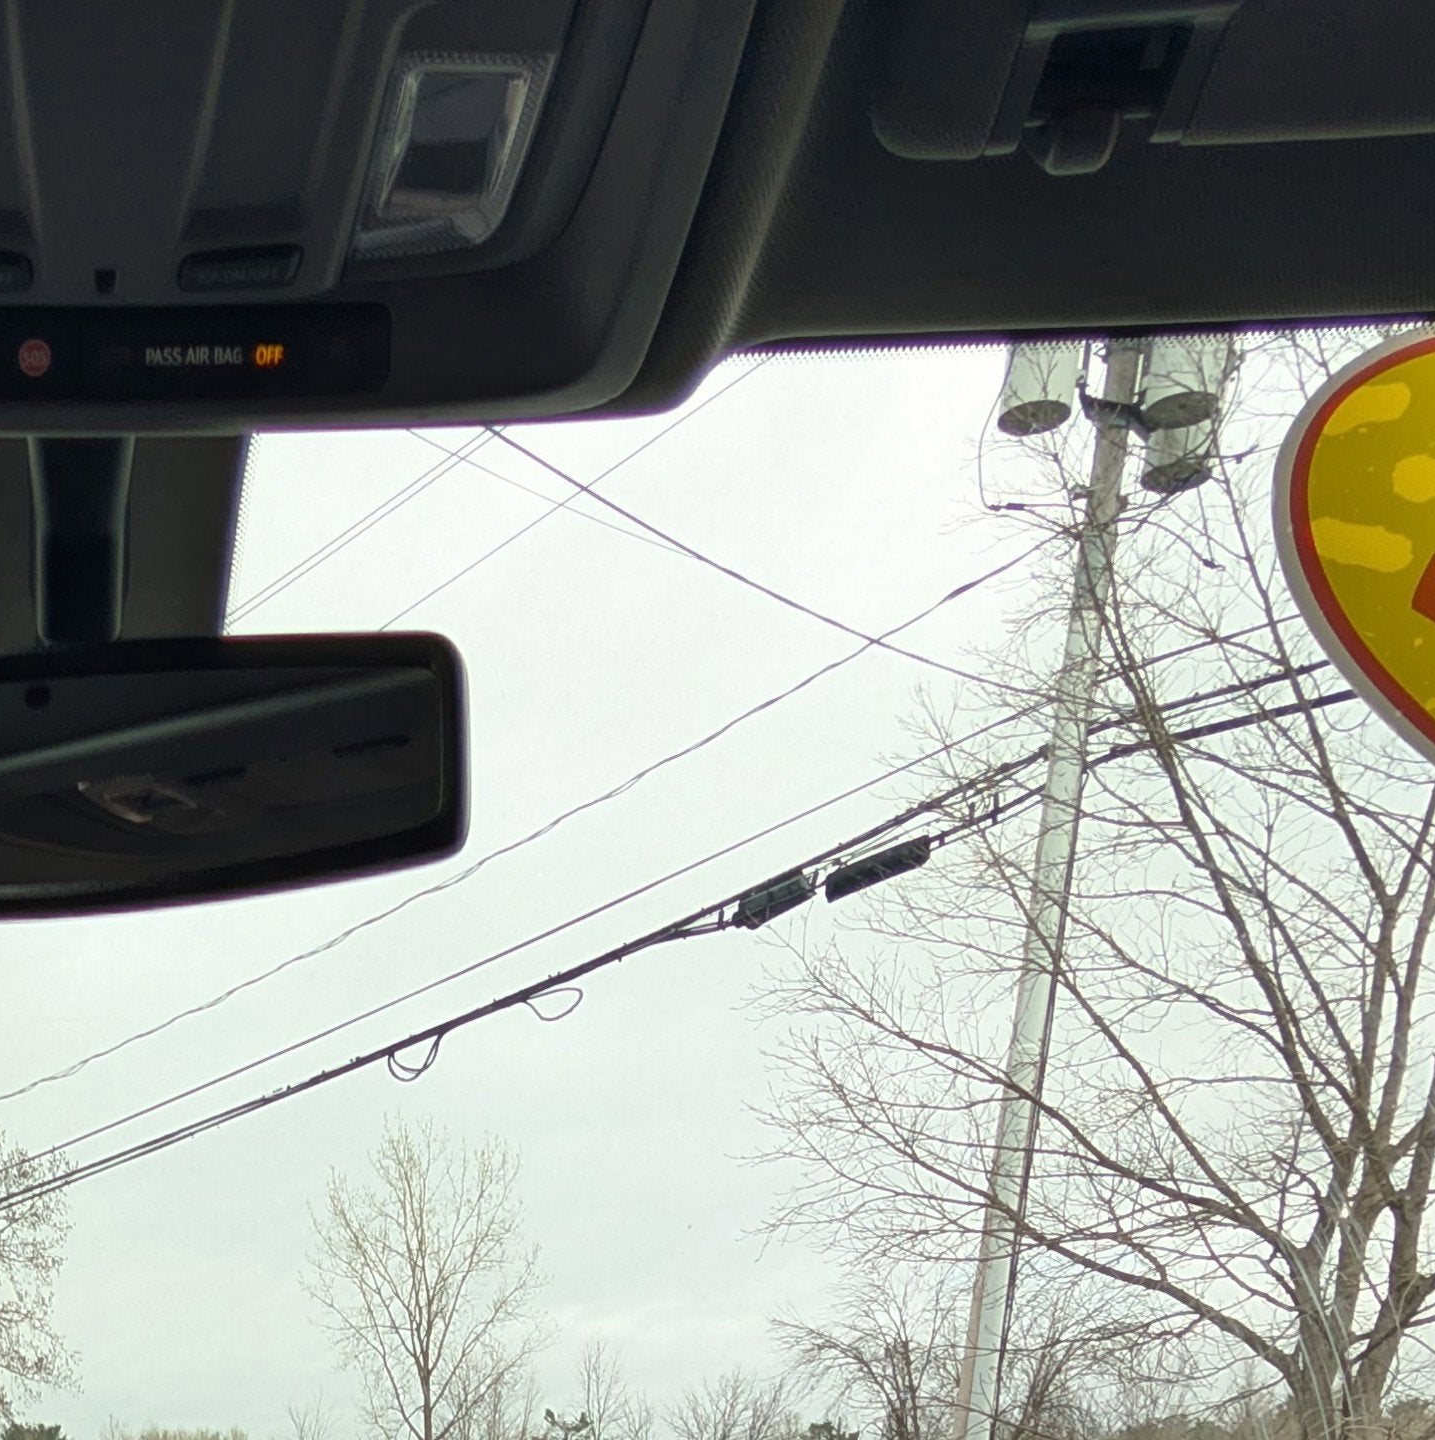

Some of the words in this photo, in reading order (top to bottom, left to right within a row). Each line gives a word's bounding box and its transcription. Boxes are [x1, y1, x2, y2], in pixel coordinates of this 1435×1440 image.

[145, 346, 182, 366] PASS
[185, 346, 211, 365] AIR
[214, 346, 243, 364] BAG
[255, 344, 284, 365] OFF
